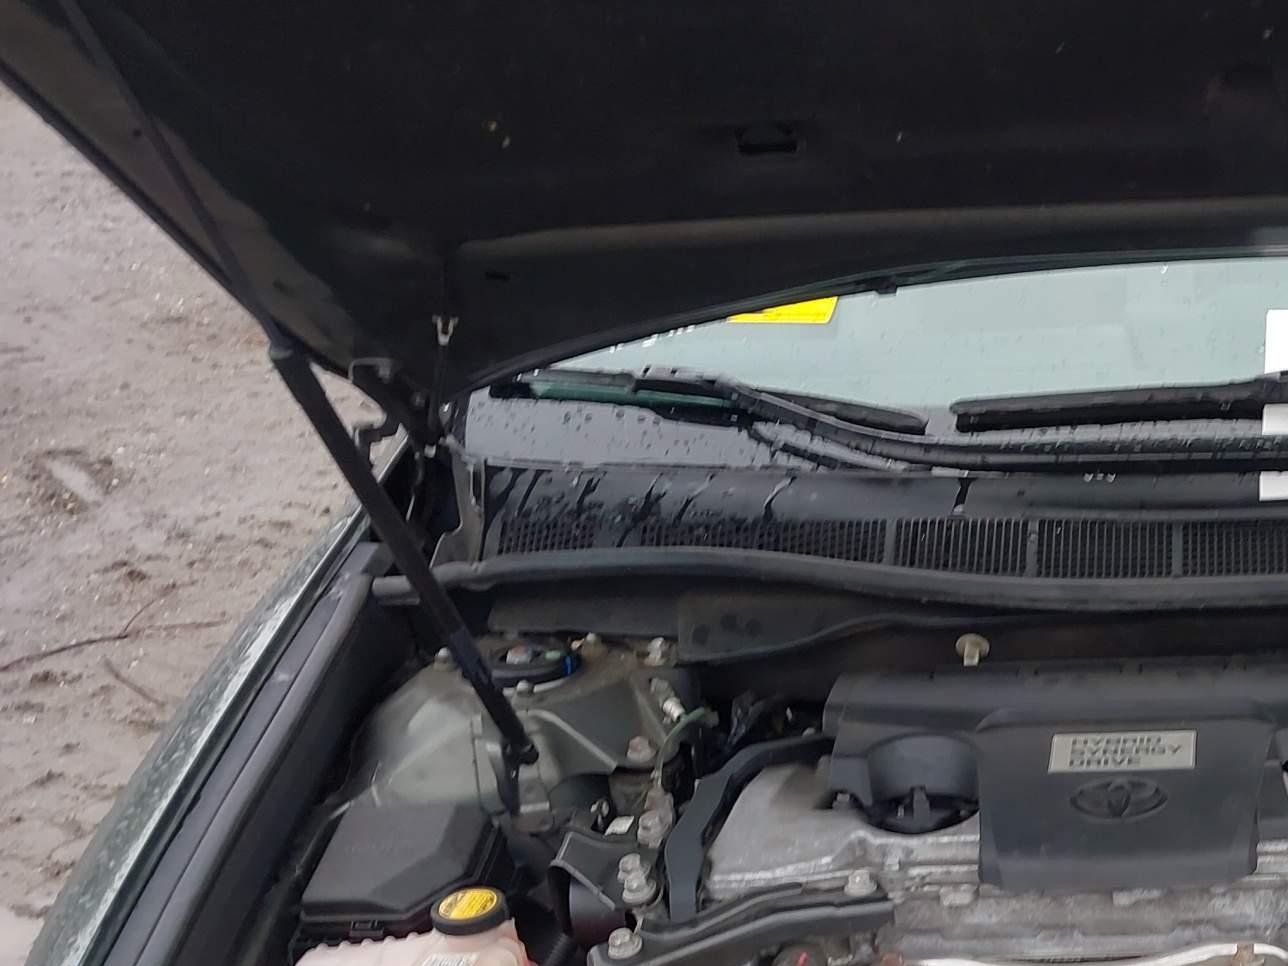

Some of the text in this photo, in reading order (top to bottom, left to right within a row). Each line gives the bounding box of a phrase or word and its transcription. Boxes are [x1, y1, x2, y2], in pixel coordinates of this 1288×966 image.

[1071, 736, 1163, 746] HYBRID
[1070, 745, 1182, 757] SYNERGY
[1068, 756, 1142, 768] DRIVE
